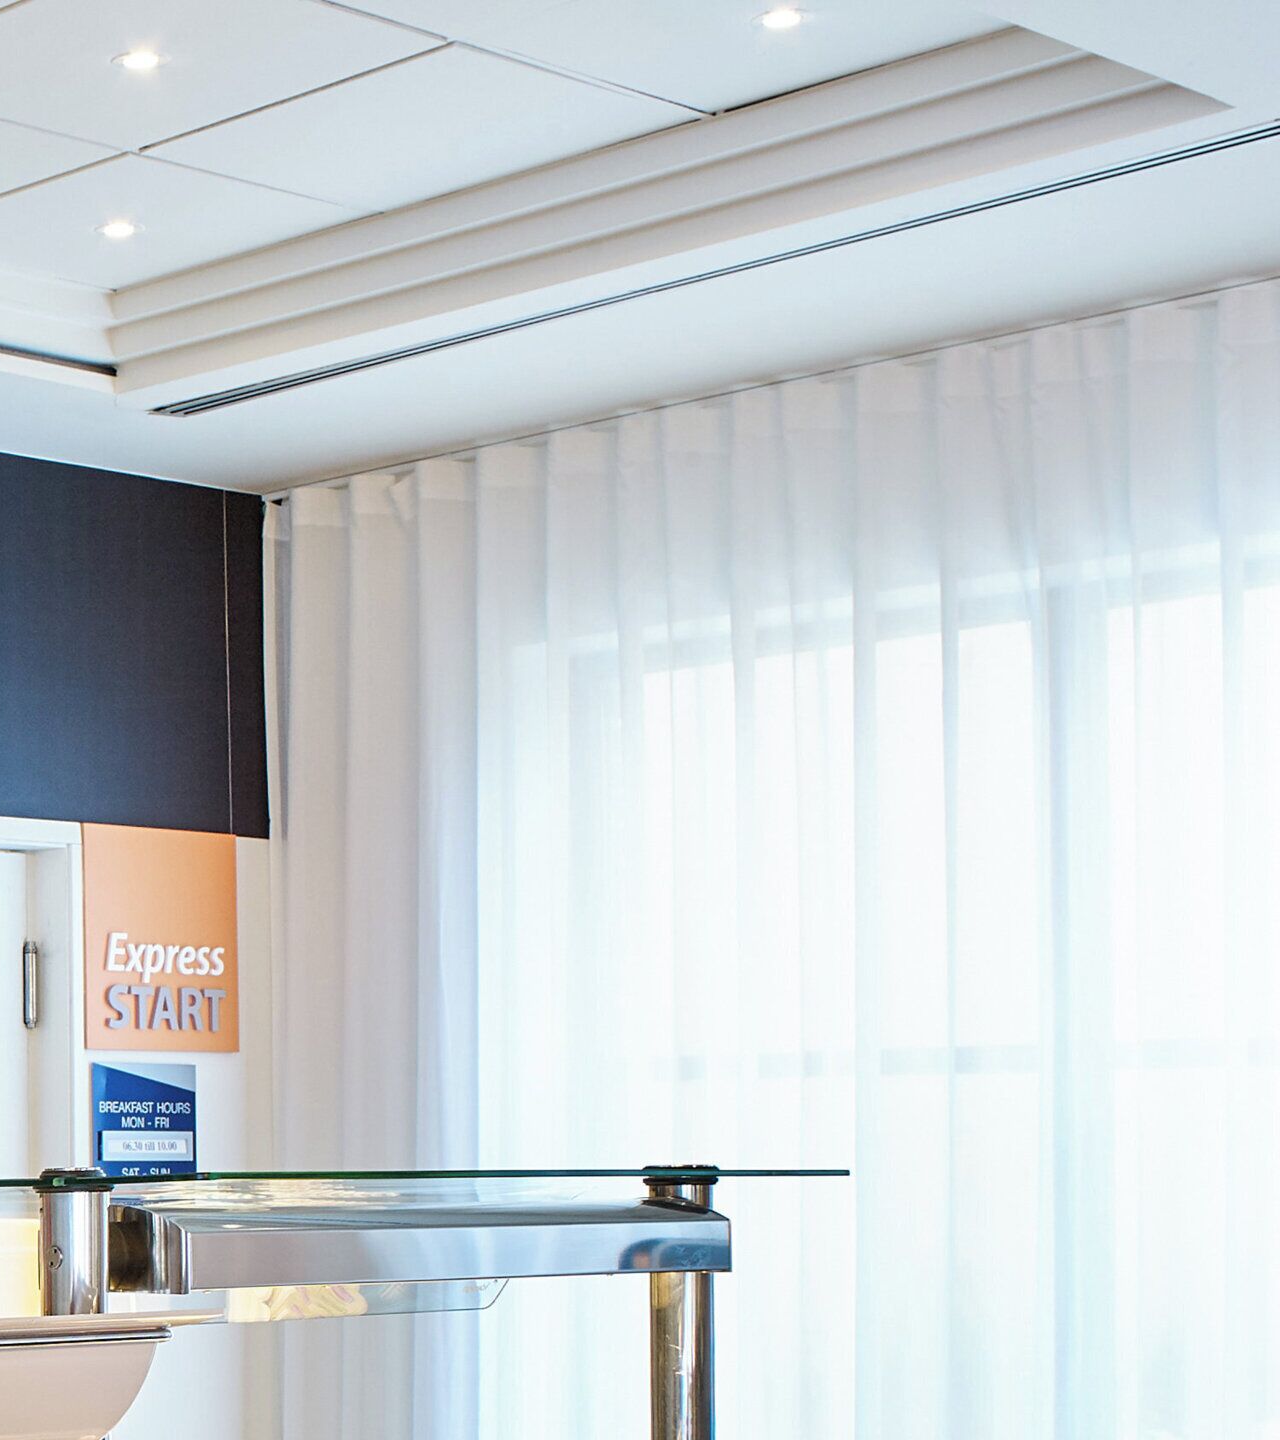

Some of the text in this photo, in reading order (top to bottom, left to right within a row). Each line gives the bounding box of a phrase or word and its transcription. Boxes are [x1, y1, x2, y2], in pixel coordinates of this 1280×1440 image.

[105, 932, 226, 984] Express
[104, 984, 227, 1033] START
[98, 1100, 191, 1115] BREAKFAST HOURS
[121, 1116, 145, 1129] MON
[154, 1116, 170, 1129] FRI
[121, 1167, 140, 1177] SAT
